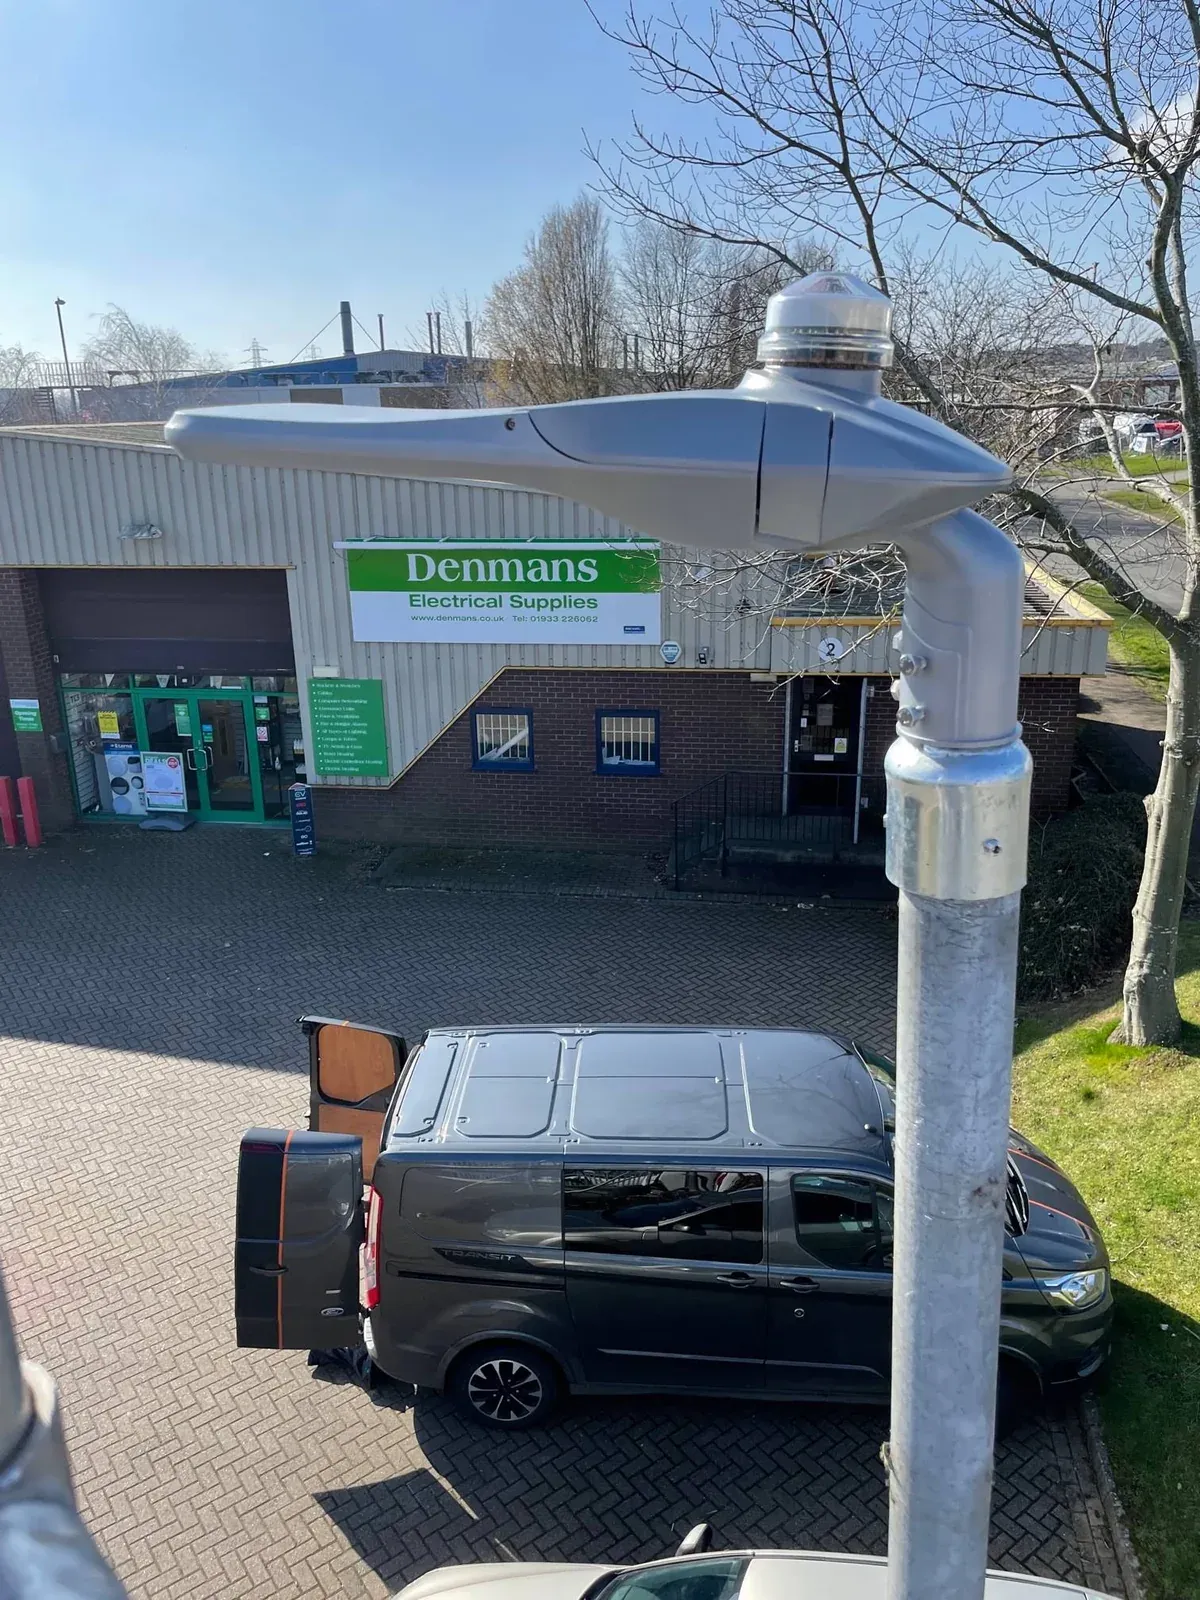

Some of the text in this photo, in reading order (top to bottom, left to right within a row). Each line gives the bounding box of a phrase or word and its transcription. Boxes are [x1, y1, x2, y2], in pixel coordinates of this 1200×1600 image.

[406, 553, 599, 582] Denmans
[409, 594, 598, 612] Electrical Supplies
[411, 614, 504, 622] www.denmans.co.uk
[561, 615, 598, 623] 226062
[825, 643, 835, 657] 2
[442, 1249, 516, 1261] TRANSIT
